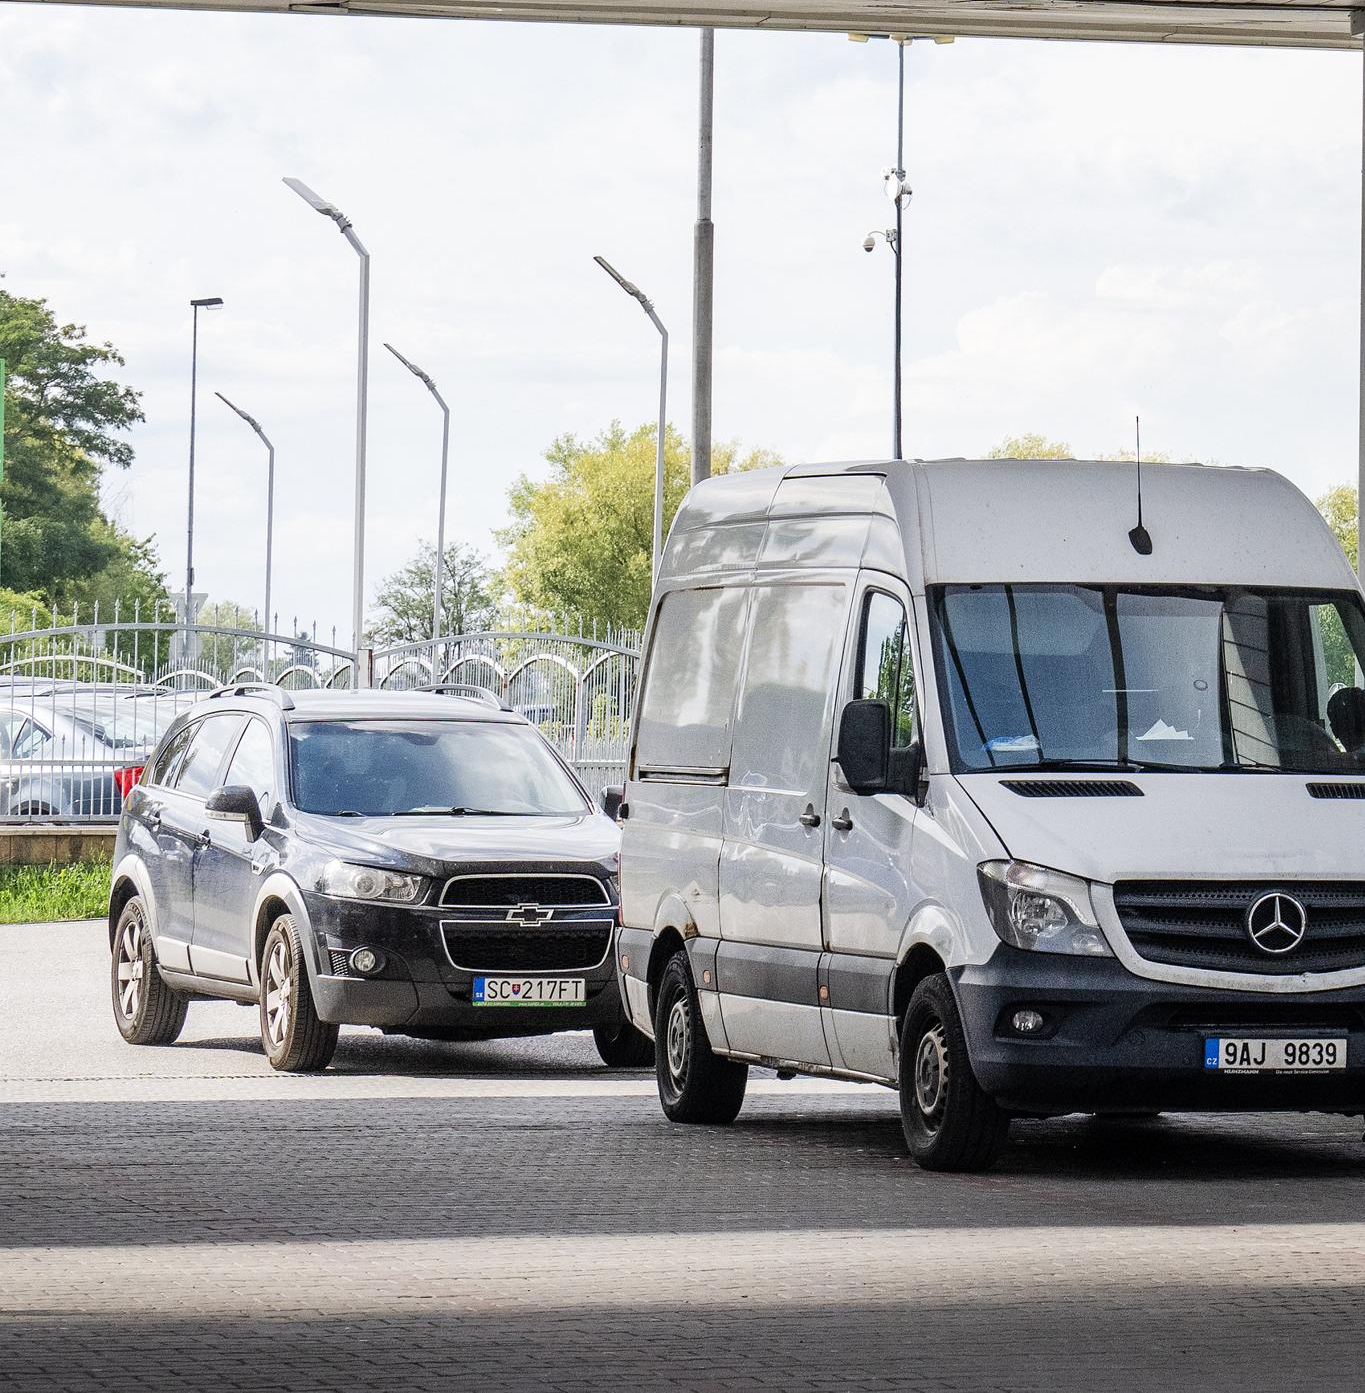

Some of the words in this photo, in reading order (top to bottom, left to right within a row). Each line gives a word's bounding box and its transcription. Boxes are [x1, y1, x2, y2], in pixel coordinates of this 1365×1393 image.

[487, 980, 511, 999] SC
[522, 980, 582, 999] 217FT
[1206, 1057, 1218, 1065] CZ
[1224, 1042, 1266, 1066] 9AJ
[1284, 1042, 1337, 1066] 9839
